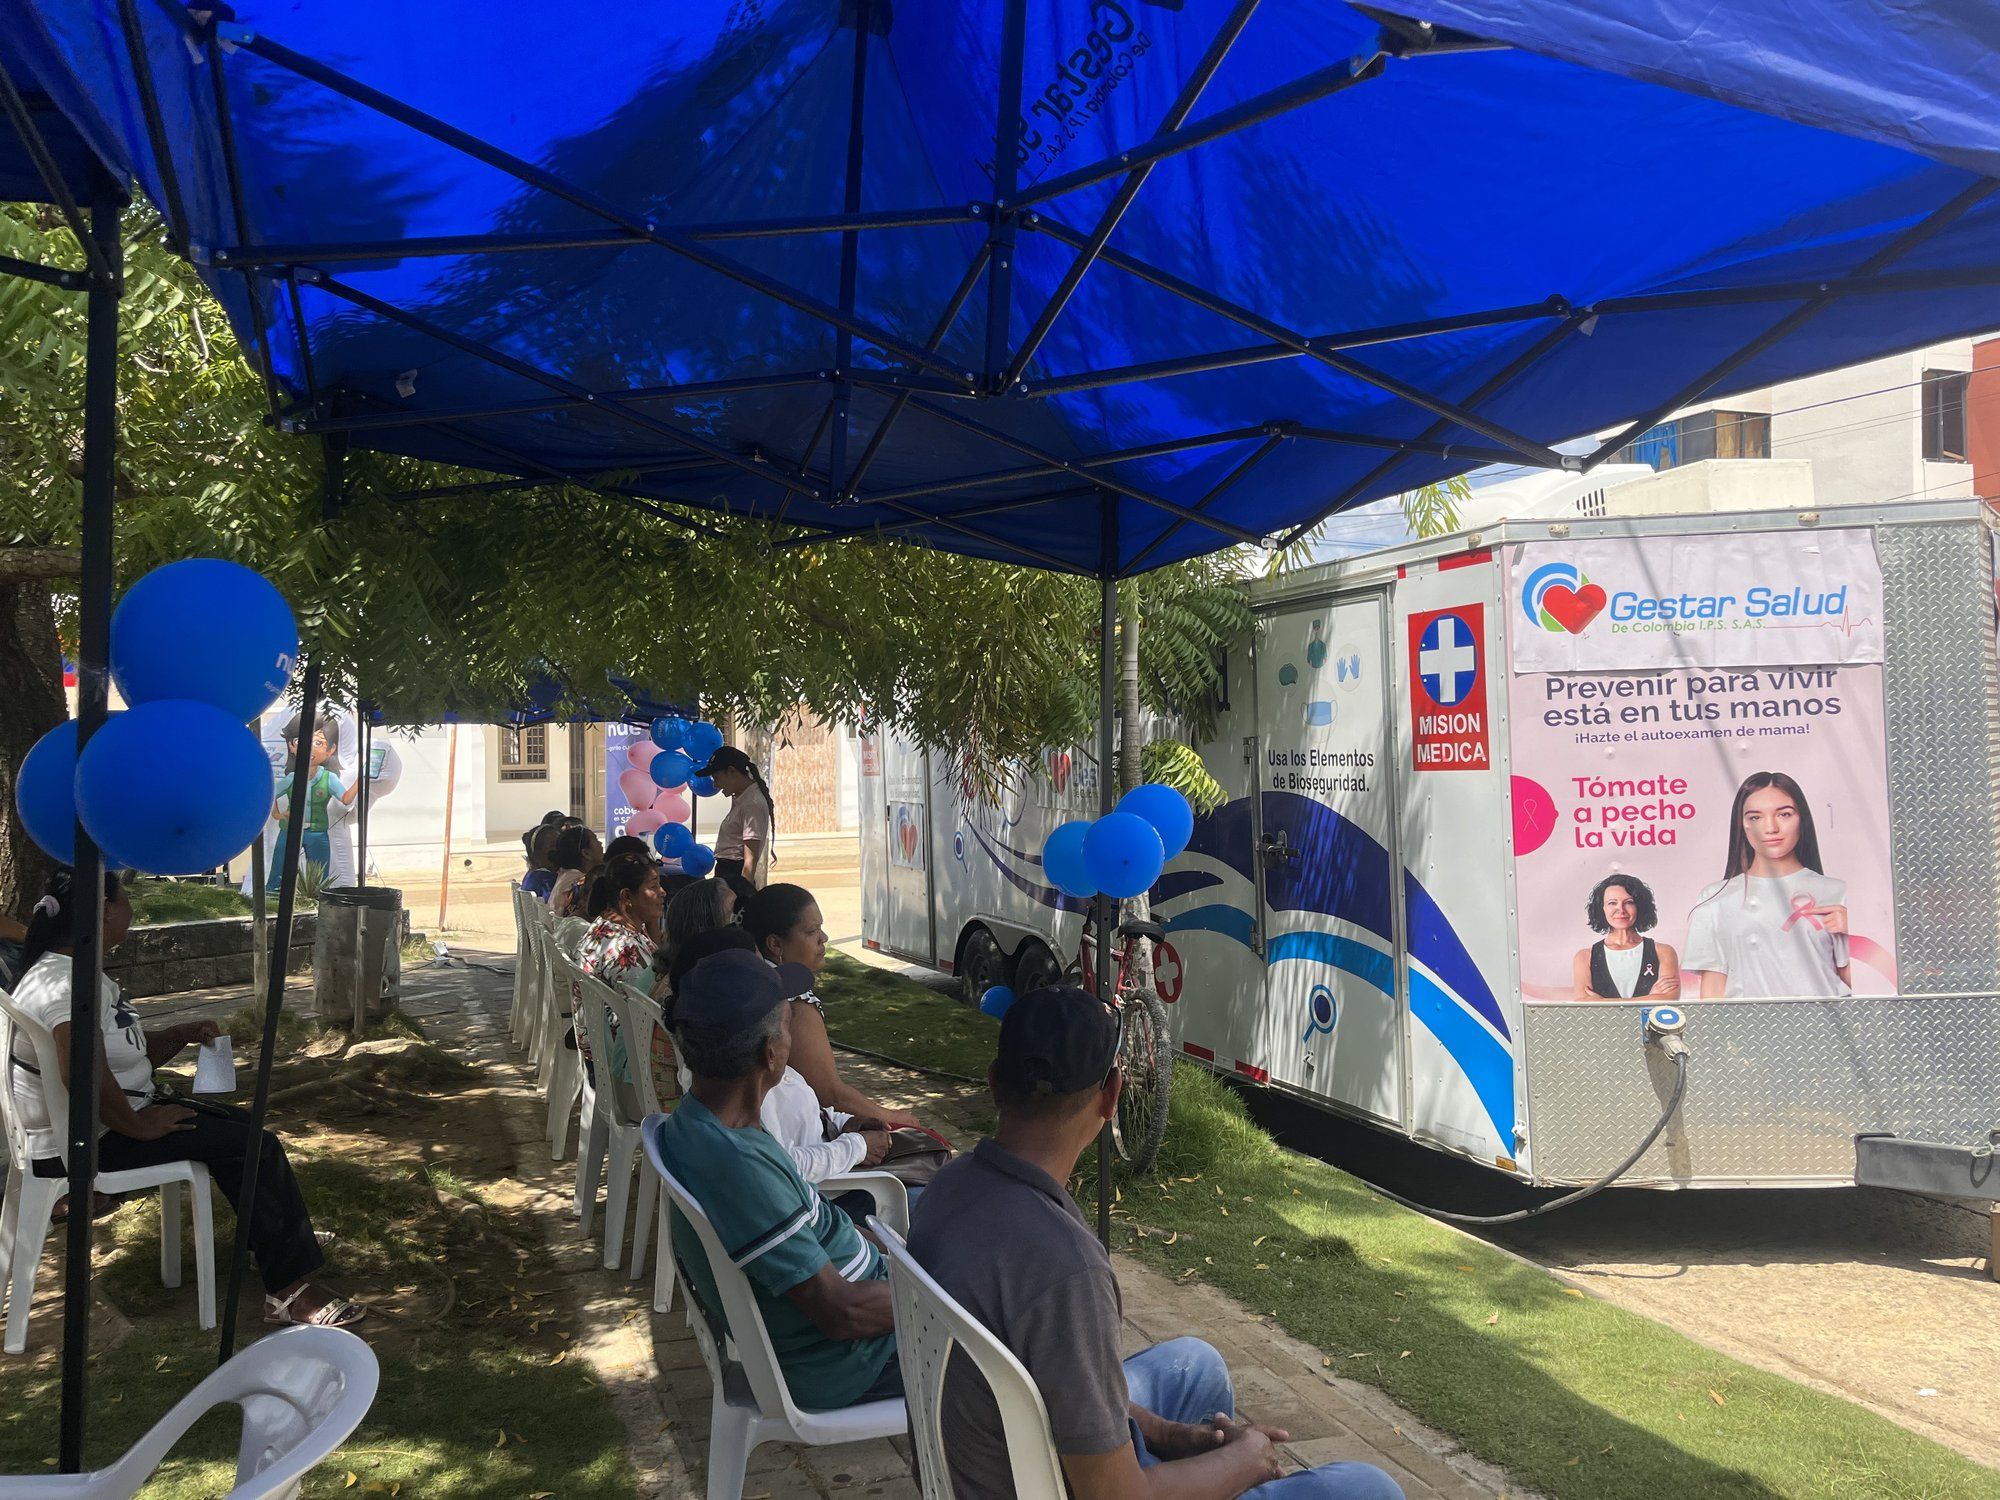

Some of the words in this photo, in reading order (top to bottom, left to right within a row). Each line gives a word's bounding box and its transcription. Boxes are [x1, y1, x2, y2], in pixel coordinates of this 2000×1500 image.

[1609, 591, 1738, 622] Gestar
[1744, 584, 1847, 618] Salud
[1611, 623, 1631, 634] De
[1632, 620, 1696, 633] Colombia
[1699, 618, 1728, 631] I.P.S.
[1732, 617, 1766, 630] S.A.S.
[1546, 672, 1678, 700] Prevenir
[1686, 673, 1760, 700] para
[1767, 666, 1838, 691] vivir
[1543, 702, 1611, 727] está
[1620, 704, 1660, 724] en
[1669, 698, 1721, 722] tus
[1730, 696, 1842, 719] manos
[1419, 712, 1481, 735] MISION
[1575, 731, 1621, 744] ¡Hazte
[1624, 730, 1638, 742] el
[1641, 727, 1732, 741] autoexamen
[1736, 725, 1755, 738] de
[1759, 723, 1810, 736] mama!
[1268, 749, 1288, 767] Usa
[1290, 749, 1307, 767] los
[1309, 748, 1374, 767] Elementos
[1417, 741, 1487, 763] MEDICA
[1273, 772, 1286, 789] de
[1288, 772, 1370, 795] Bioseguridad.
[1572, 774, 1688, 799] Tómate
[1573, 806, 1592, 824] a
[1602, 798, 1696, 828] pecho
[1575, 826, 1603, 848] la
[1610, 824, 1676, 847] vida
